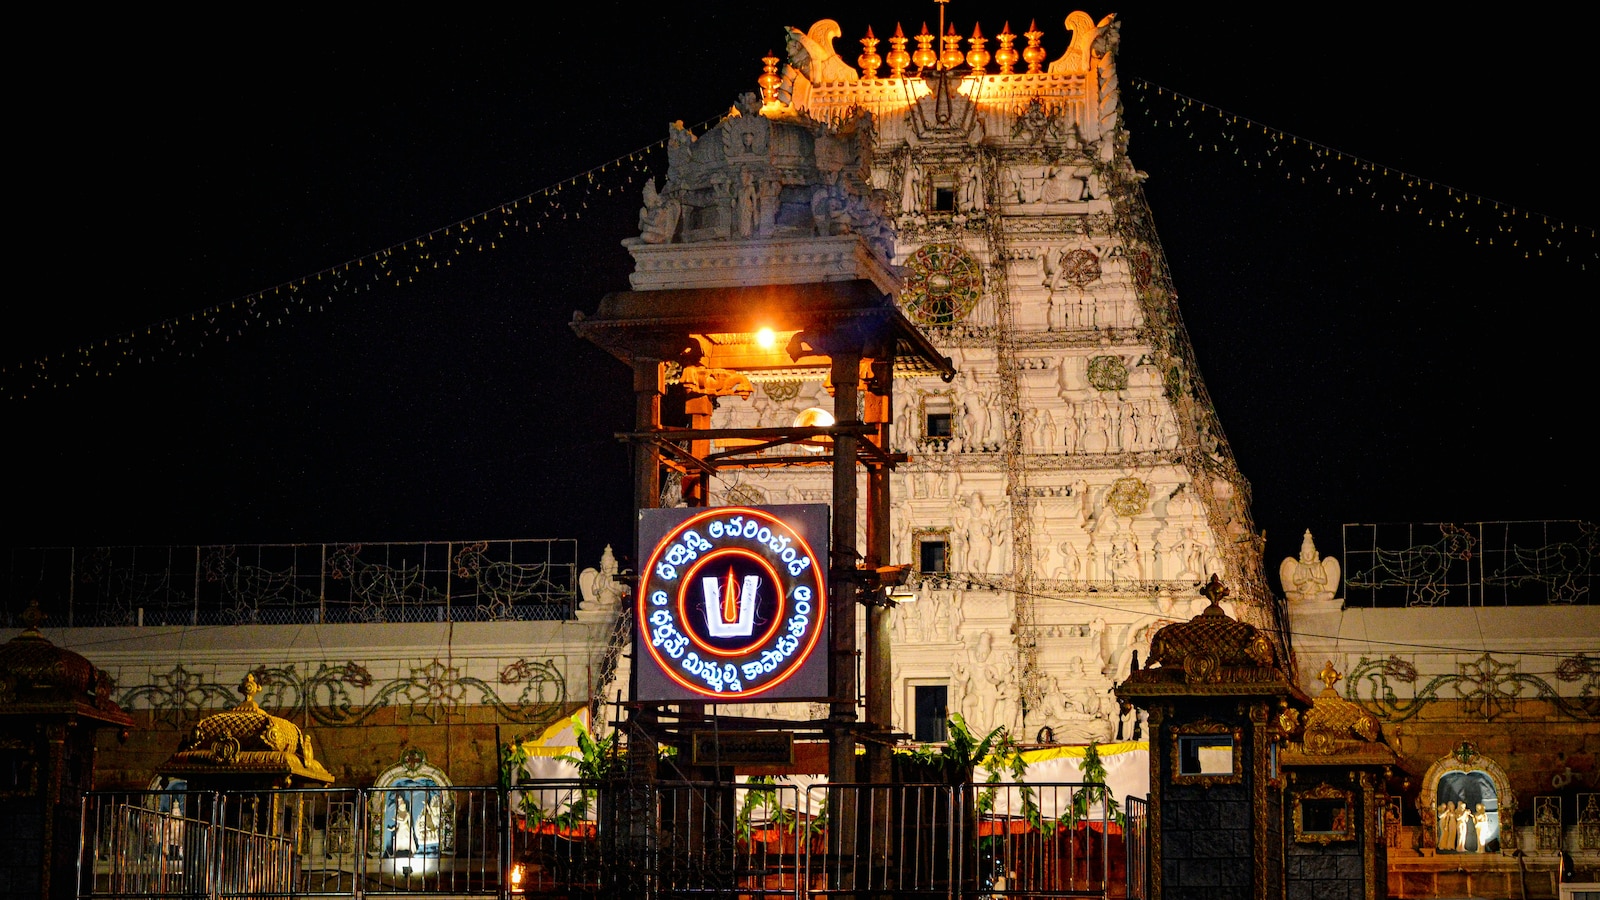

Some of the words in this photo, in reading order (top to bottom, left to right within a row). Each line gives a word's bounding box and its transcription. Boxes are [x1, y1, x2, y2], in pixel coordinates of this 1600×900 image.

[655, 529, 713, 581] ధర్మాన్ని
[708, 516, 811, 577] ఆచరించండి
[651, 590, 668, 606] ఆ
[649, 609, 690, 659] ధర్మమే
[740, 585, 812, 681] కాపాడుతుంది
[681, 651, 743, 693] మిమ్మల్ని
